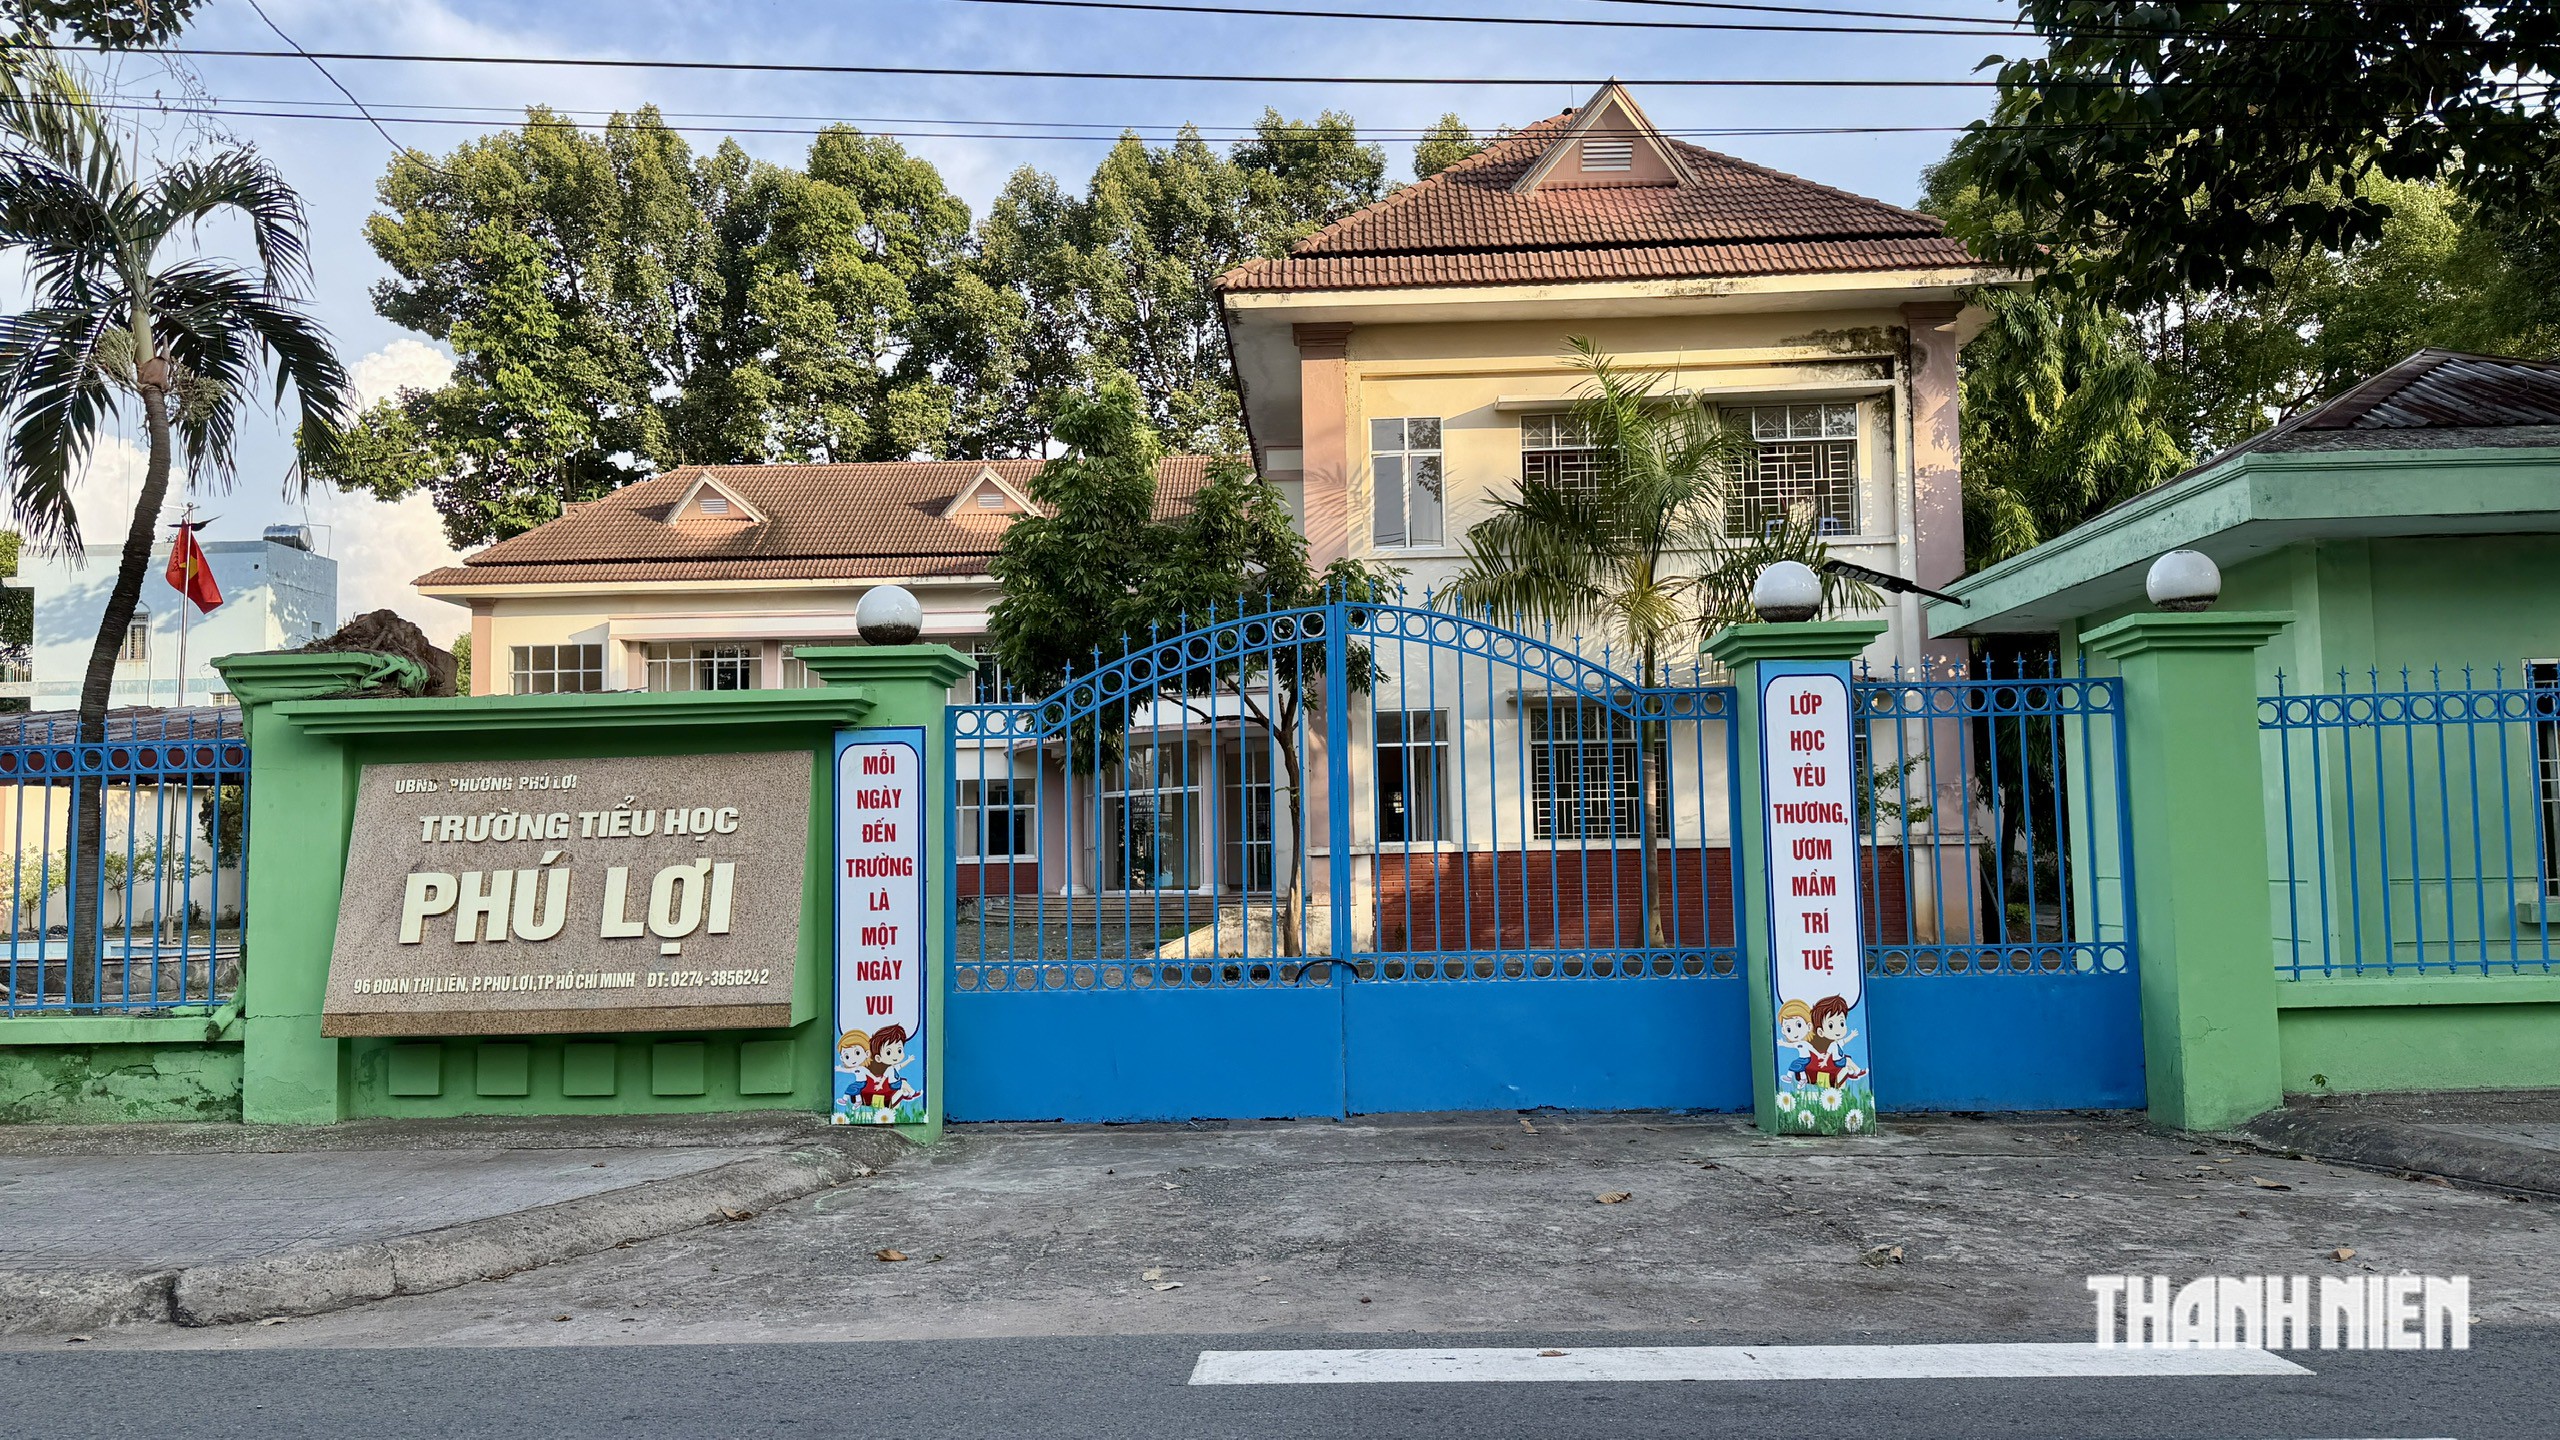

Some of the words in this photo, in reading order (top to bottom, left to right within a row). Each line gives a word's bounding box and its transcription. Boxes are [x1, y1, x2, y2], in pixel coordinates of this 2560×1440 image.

[1790, 690, 1823, 716] LỚP
[1790, 729, 1825, 756] HỌC
[862, 748, 896, 776] MỖI
[1793, 762, 1826, 788] YÊU
[518, 773, 550, 790] PHÚ
[552, 774, 578, 793] LỢI
[856, 784, 902, 810] NGÀY
[420, 807, 570, 842] TRƯỜNG
[578, 796, 656, 838] TIỂU
[664, 807, 740, 841] HỌC
[1773, 802, 1849, 826] THƯƠNG,
[861, 817, 896, 844] ĐẾN
[1792, 838, 1832, 860] ƯƠM
[846, 850, 913, 878] TRƯỜNG
[1792, 868, 1836, 897] MẦM
[399, 850, 571, 944] PHÚ
[600, 858, 736, 955] LỢI
[869, 887, 890, 911] LÀ
[1801, 907, 1829, 933] TRÍ
[861, 922, 898, 950] MỘT
[856, 956, 902, 981] NGÀY
[1801, 945, 1834, 975] TUỆ
[353, 978, 371, 994] 96
[413, 976, 434, 995] THỊ
[436, 973, 469, 993] LIÊN,
[555, 968, 575, 990] HỒ
[575, 968, 599, 989] CHÍ
[600, 972, 636, 988] MINH
[866, 995, 893, 1015] VUI
